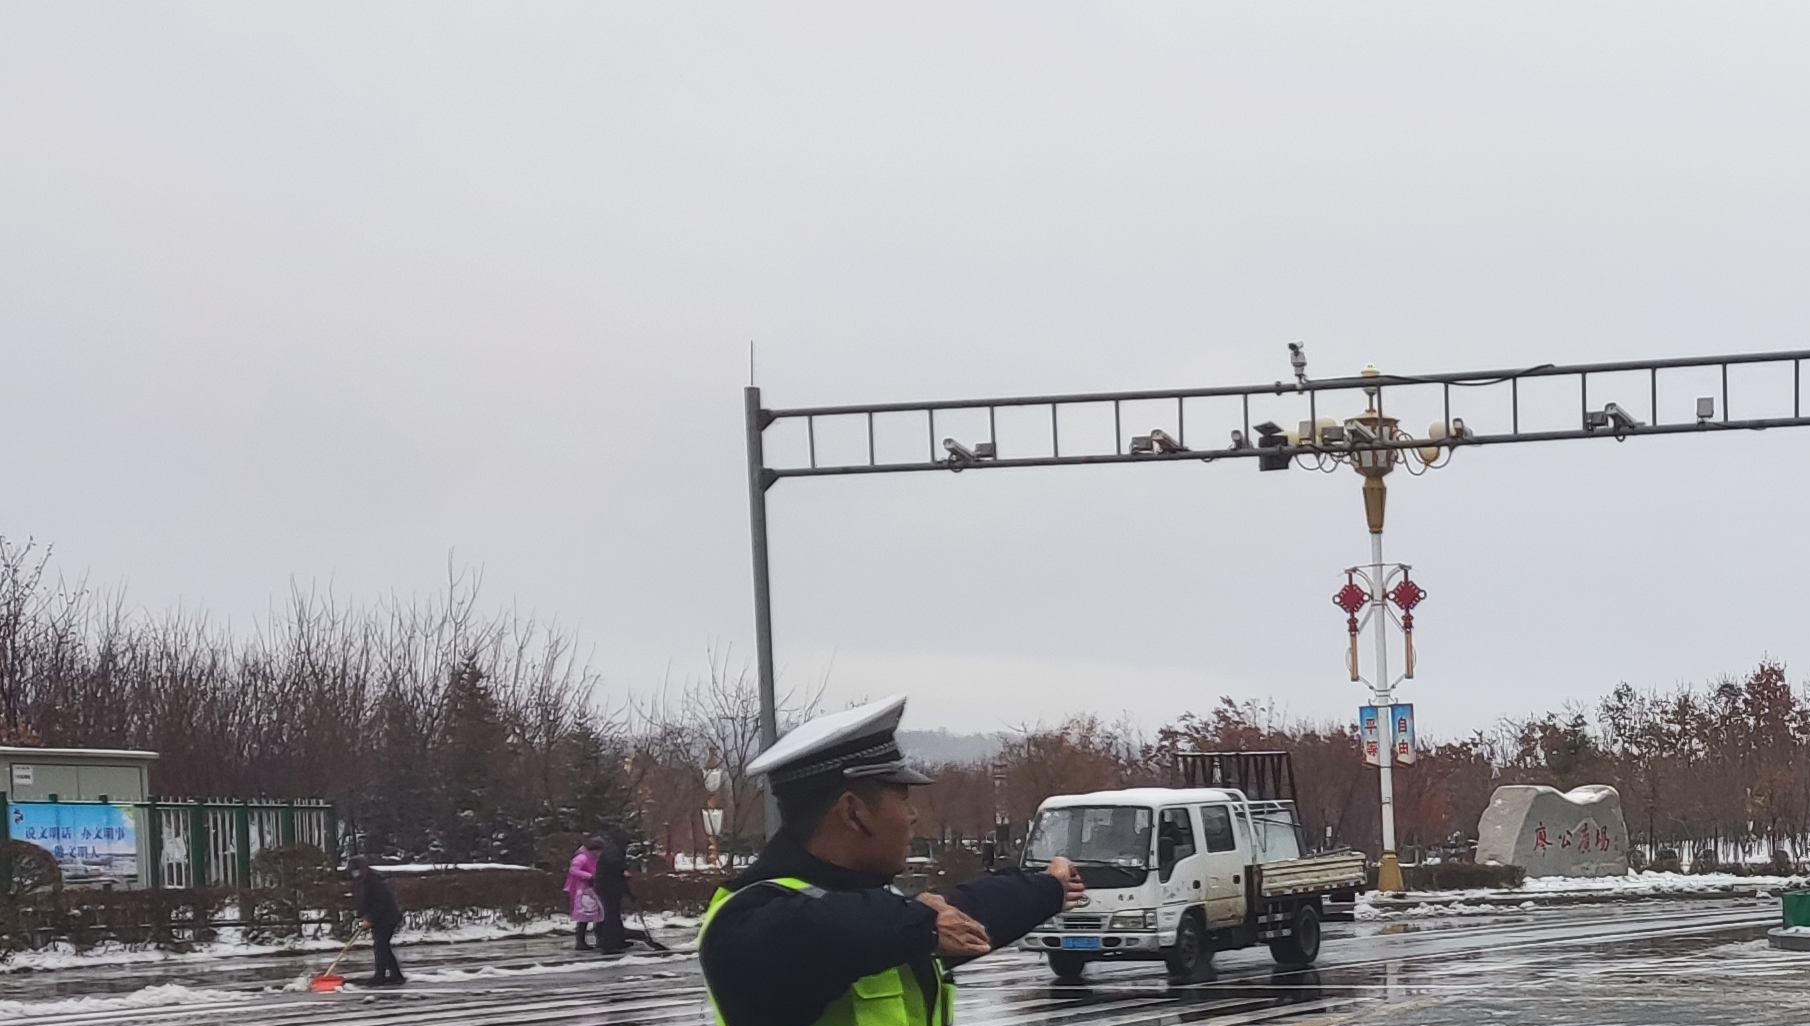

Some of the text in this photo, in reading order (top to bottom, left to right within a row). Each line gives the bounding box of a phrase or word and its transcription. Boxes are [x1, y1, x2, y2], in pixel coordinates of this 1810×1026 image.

[1397, 716, 1408, 754] 自由
[25, 826, 126, 840] 说文明话 办文明事
